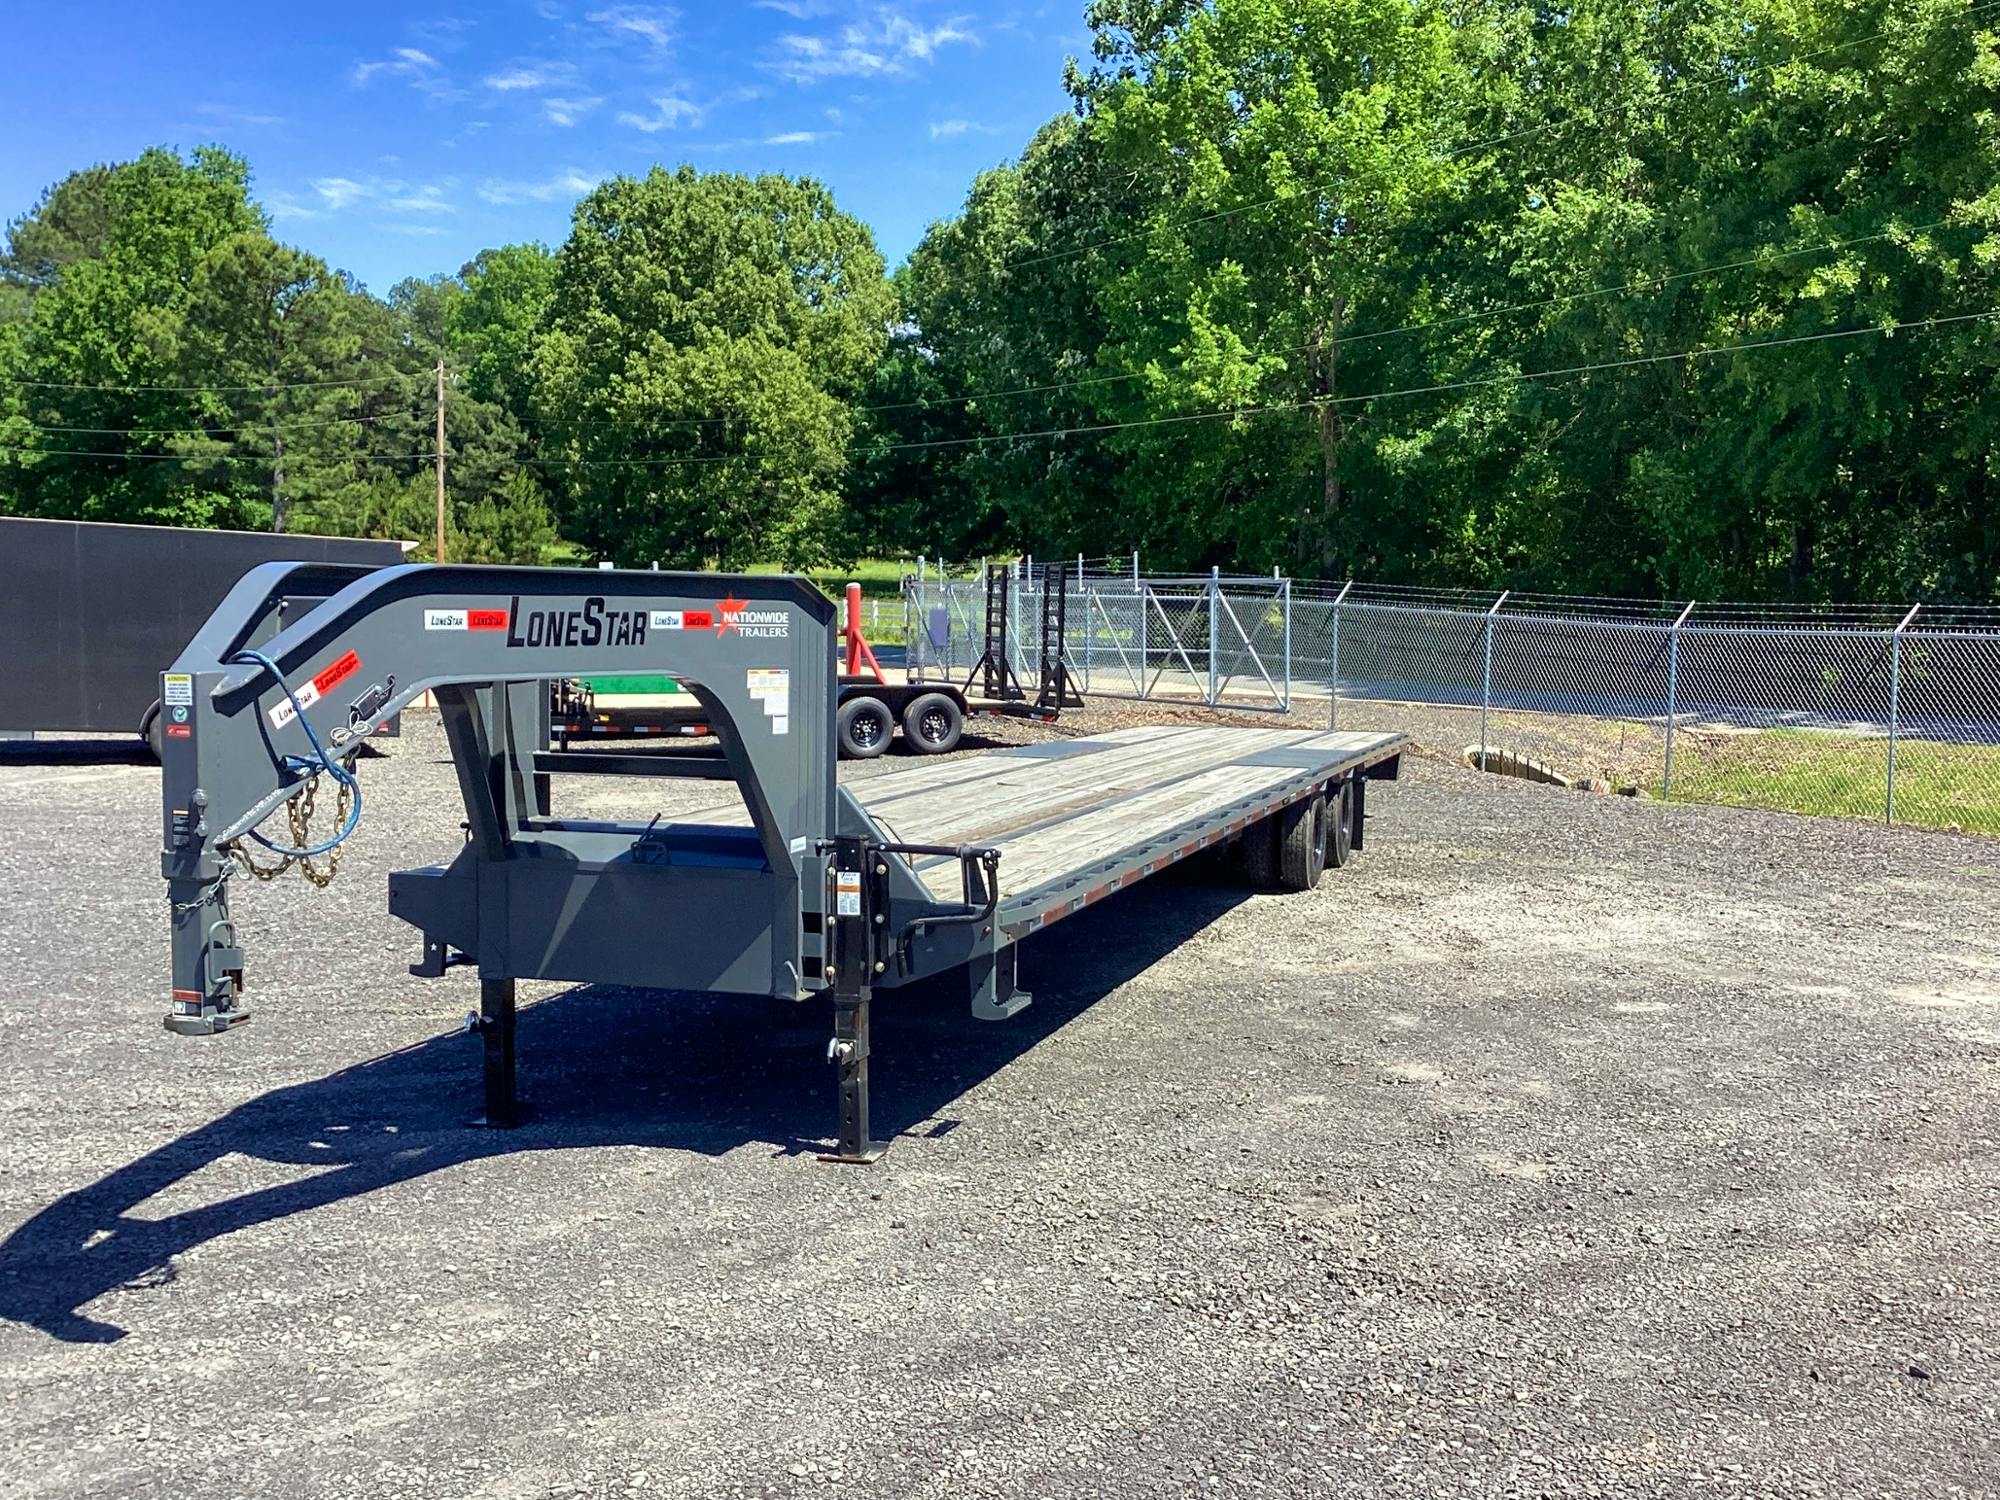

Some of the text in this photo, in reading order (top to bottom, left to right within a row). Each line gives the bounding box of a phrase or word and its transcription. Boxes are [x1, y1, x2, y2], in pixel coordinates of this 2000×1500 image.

[723, 611, 789, 624] NATIONWIDE
[738, 627, 789, 638] TRAILERS
[278, 691, 313, 722] LONTAR
